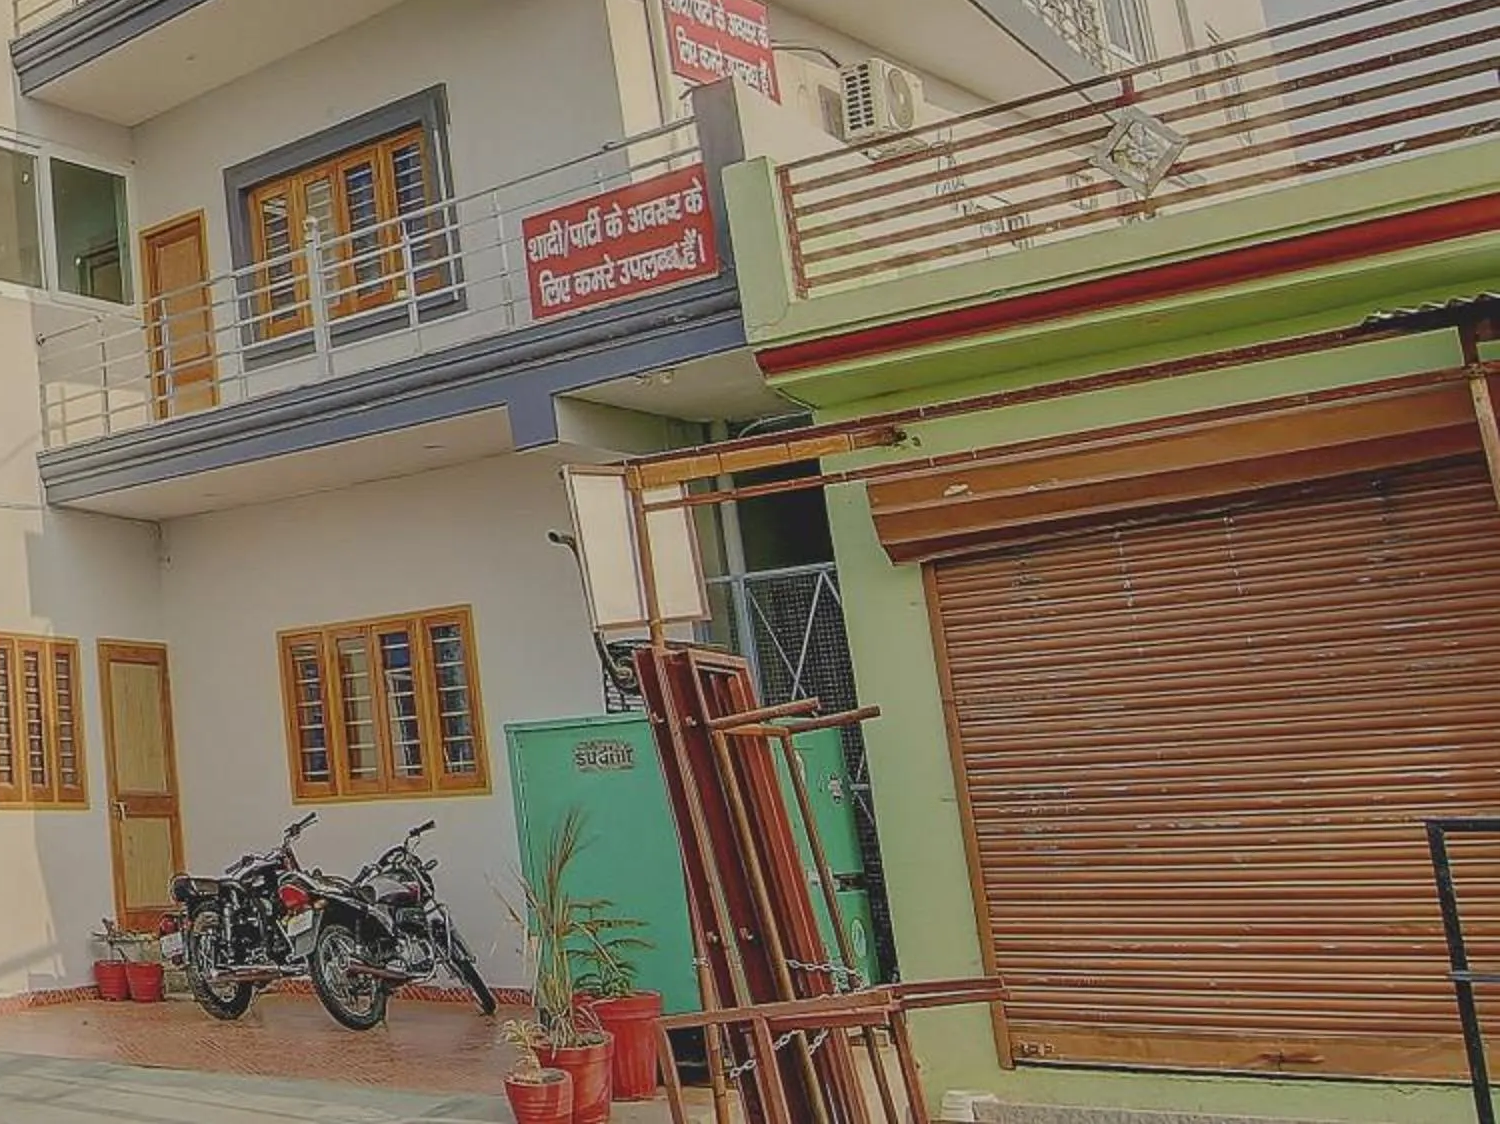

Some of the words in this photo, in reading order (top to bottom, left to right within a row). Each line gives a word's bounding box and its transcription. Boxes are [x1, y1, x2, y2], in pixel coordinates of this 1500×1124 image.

[604, 201, 624, 239] के
[627, 191, 683, 233] अवसर
[684, 176, 704, 215] के
[539, 269, 571, 307] लिए
[574, 254, 616, 296] कमरे
